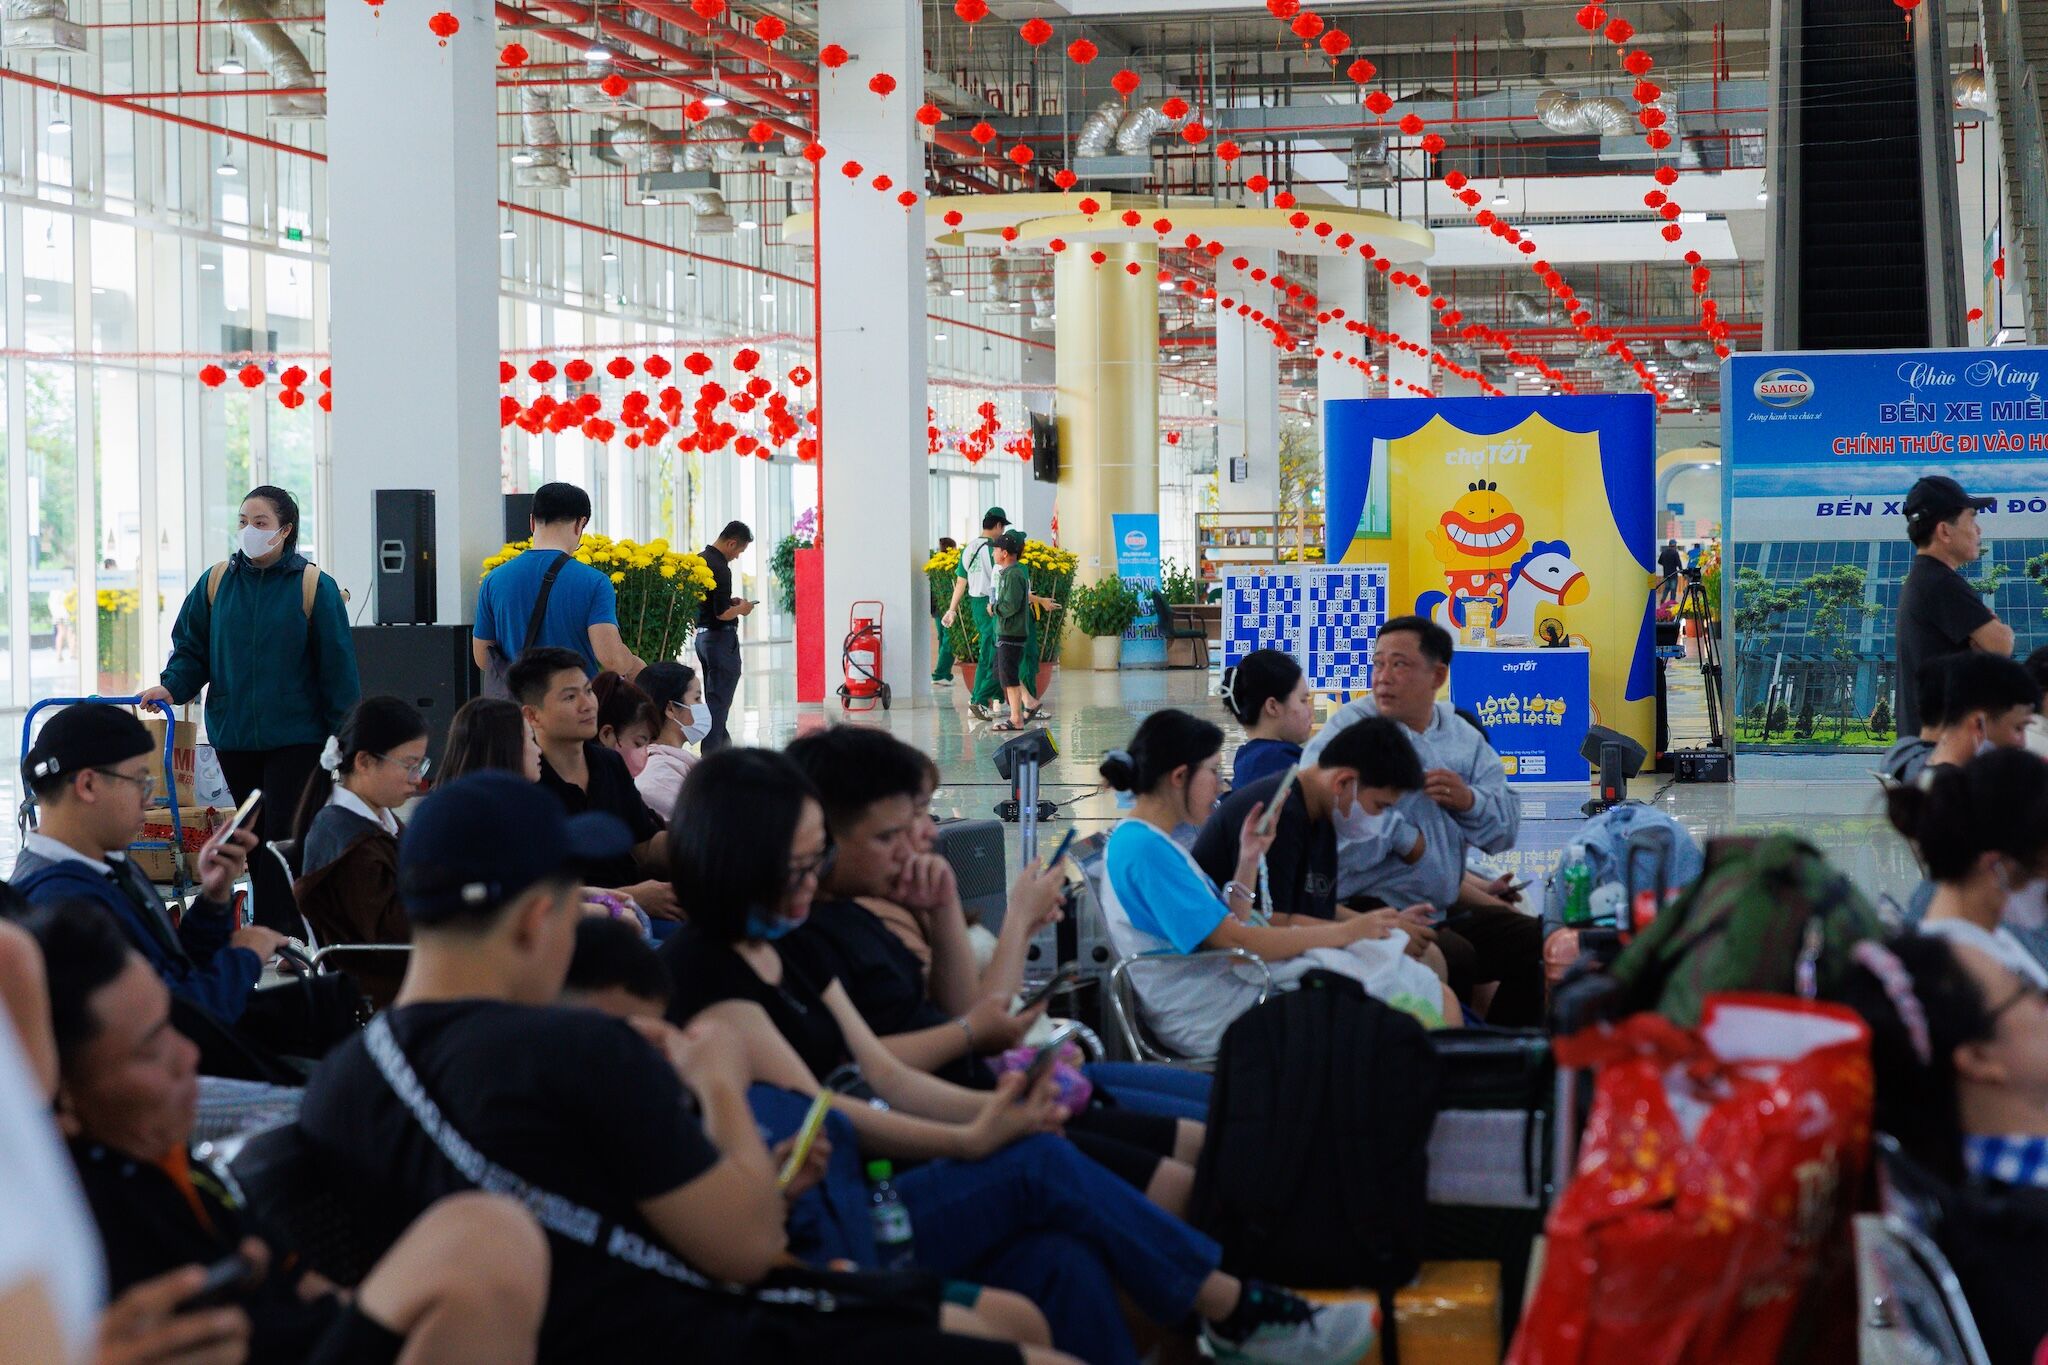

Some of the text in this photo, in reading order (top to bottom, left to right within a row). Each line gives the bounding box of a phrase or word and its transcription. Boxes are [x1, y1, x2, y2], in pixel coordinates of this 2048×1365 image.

[1897, 359, 2041, 393] Chào Mừng
[1760, 384, 1808, 394] SAMCO
[1880, 392, 1937, 423] BẾN
[1944, 401, 1982, 423] XE
[1832, 430, 2048, 455] CHÍNH THỨC ĐI VÀO H
[1816, 494, 1873, 516] BẾN
[1236, 579, 1242, 588] 13
[1244, 578, 1250, 588] 22
[1261, 579, 1267, 587] 41
[1277, 578, 1283, 587] 61
[1320, 577, 1326, 586] 16
[1361, 576, 1367, 585] 65
[1244, 591, 1250, 600] 24
[1253, 591, 1259, 600] 34
[1269, 590, 1275, 600] 52
[1285, 590, 1291, 599] 71
[1320, 589, 1375, 598] 11 32 45 68 78
[1327, 602, 1334, 611] 21
[1335, 602, 1342, 611] 33
[1352, 601, 1359, 610] 57
[1369, 601, 1375, 610] 73
[1243, 617, 1250, 627] 23
[1285, 617, 1291, 626] 75
[1344, 615, 1350, 625] 43
[1368, 615, 1375, 624] 77
[1285, 629, 1291, 638] 72
[1293, 629, 1299, 638] 84
[1319, 628, 1366, 637] 12 31 54 62
[1235, 643, 1241, 651] 14
[1243, 642, 1249, 651] 28
[1319, 640, 1375, 649] 19 39 40 70
[1327, 654, 1333, 663] 29
[1352, 654, 1358, 663] 58
[1318, 666, 1366, 675] 17 38 44 69
[1326, 679, 1333, 687] 27
[1334, 679, 1341, 687] 37
[1351, 678, 1358, 687] 55
[1359, 678, 1366, 687] 67
